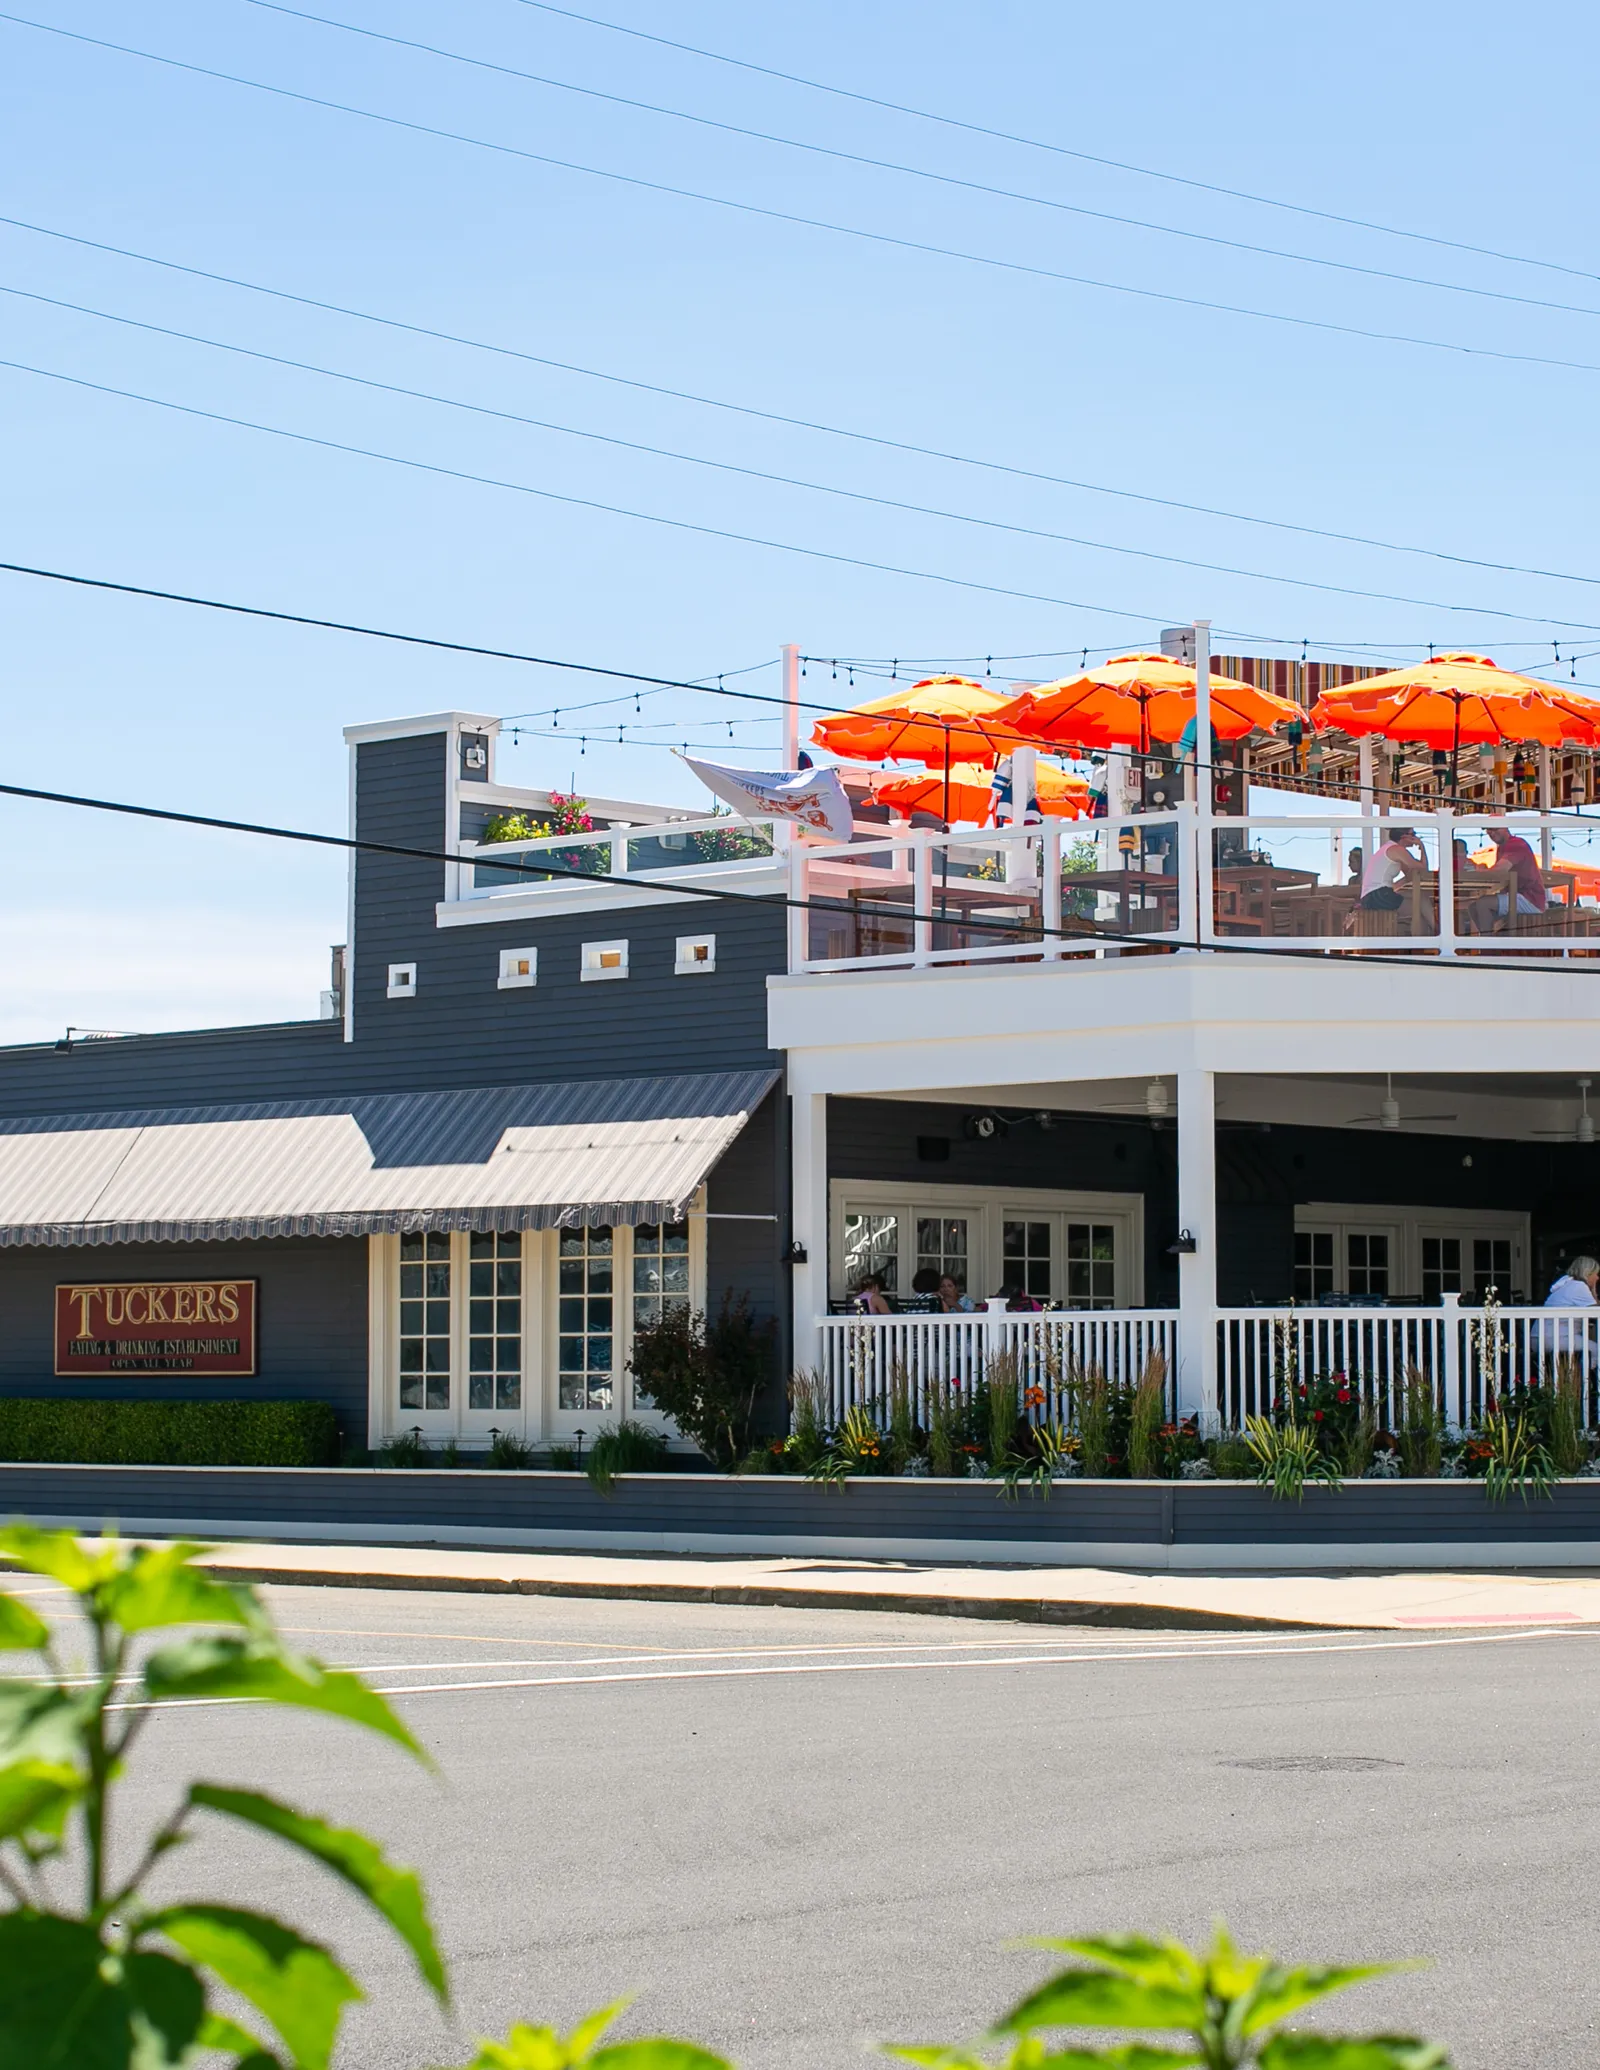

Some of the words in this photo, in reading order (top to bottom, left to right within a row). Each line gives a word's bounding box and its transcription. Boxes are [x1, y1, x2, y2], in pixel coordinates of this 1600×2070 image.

[1129, 770, 1141, 788] EXI
[733, 781, 765, 795] CKERS
[70, 1285, 239, 1338] TUCKERS
[70, 1340, 101, 1355] EATING
[104, 1340, 111, 1355] &
[115, 1339, 160, 1355] DRINKING
[164, 1338, 238, 1354] ESTABLISHMENT
[111, 1359, 137, 1368] OPEN
[166, 1359, 193, 1368] YEAR
